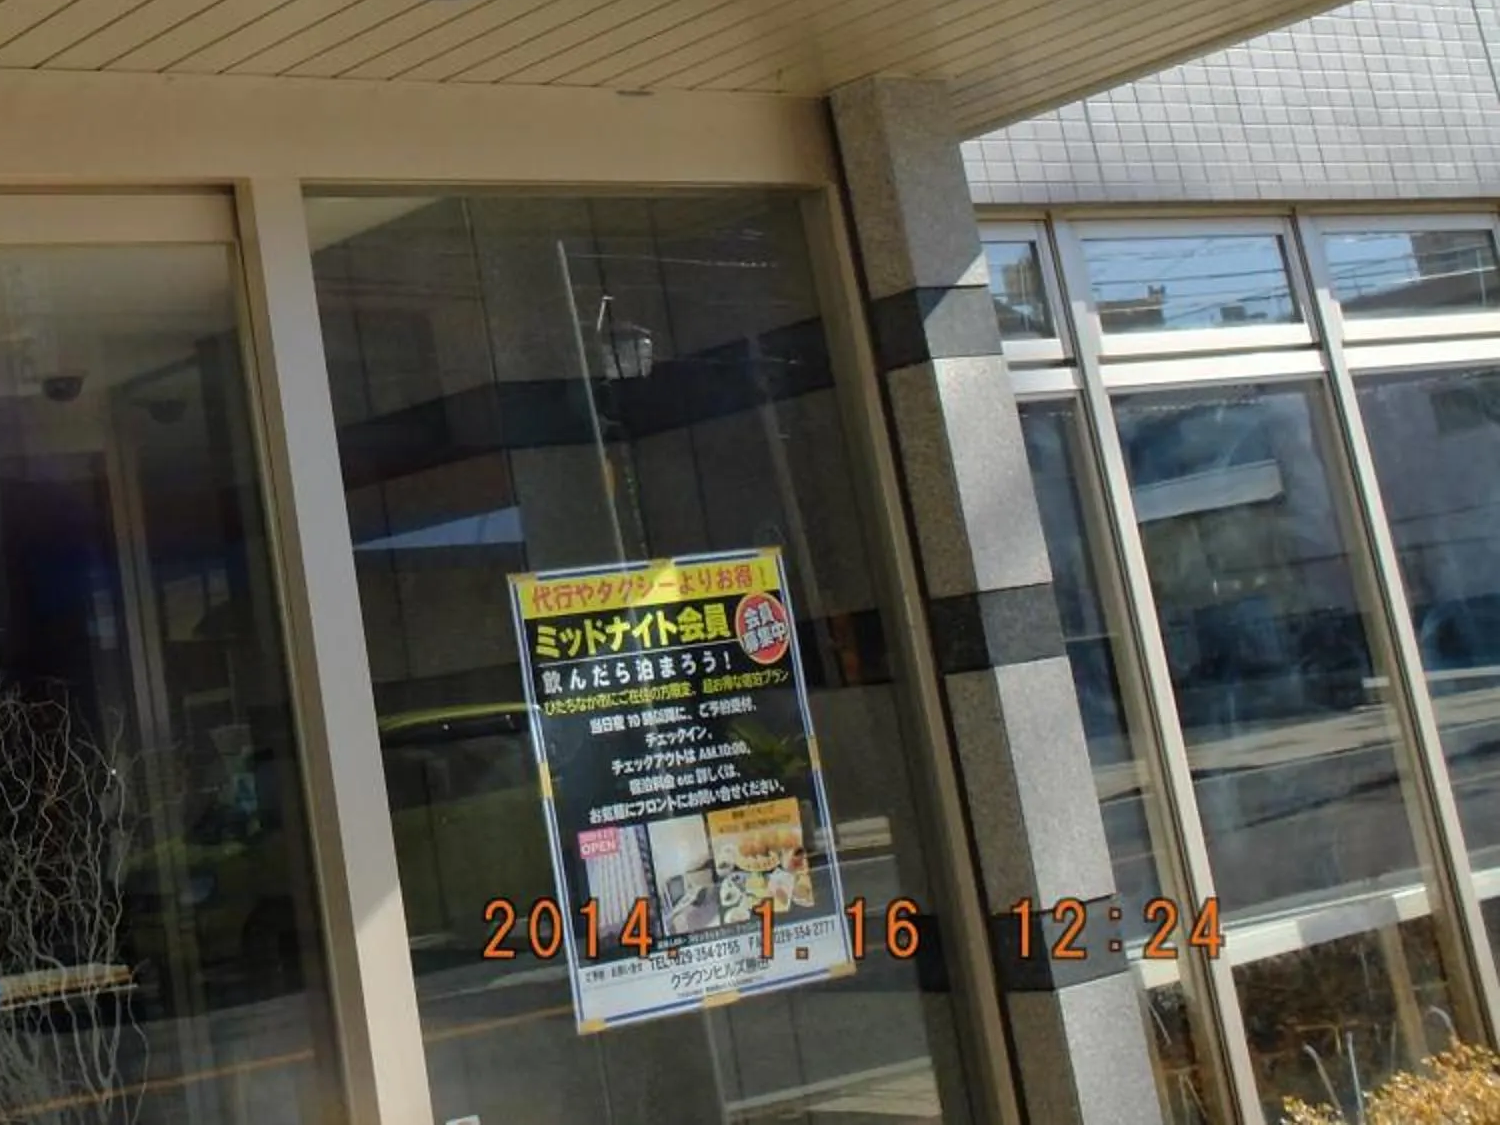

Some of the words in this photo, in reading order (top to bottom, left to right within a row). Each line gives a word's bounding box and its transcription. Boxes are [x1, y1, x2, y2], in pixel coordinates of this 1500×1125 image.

[535, 603, 731, 659] ミッドナイト会員
[541, 651, 732, 694] 飲んだら泊まろう！
[580, 840, 617, 856] OPEN
